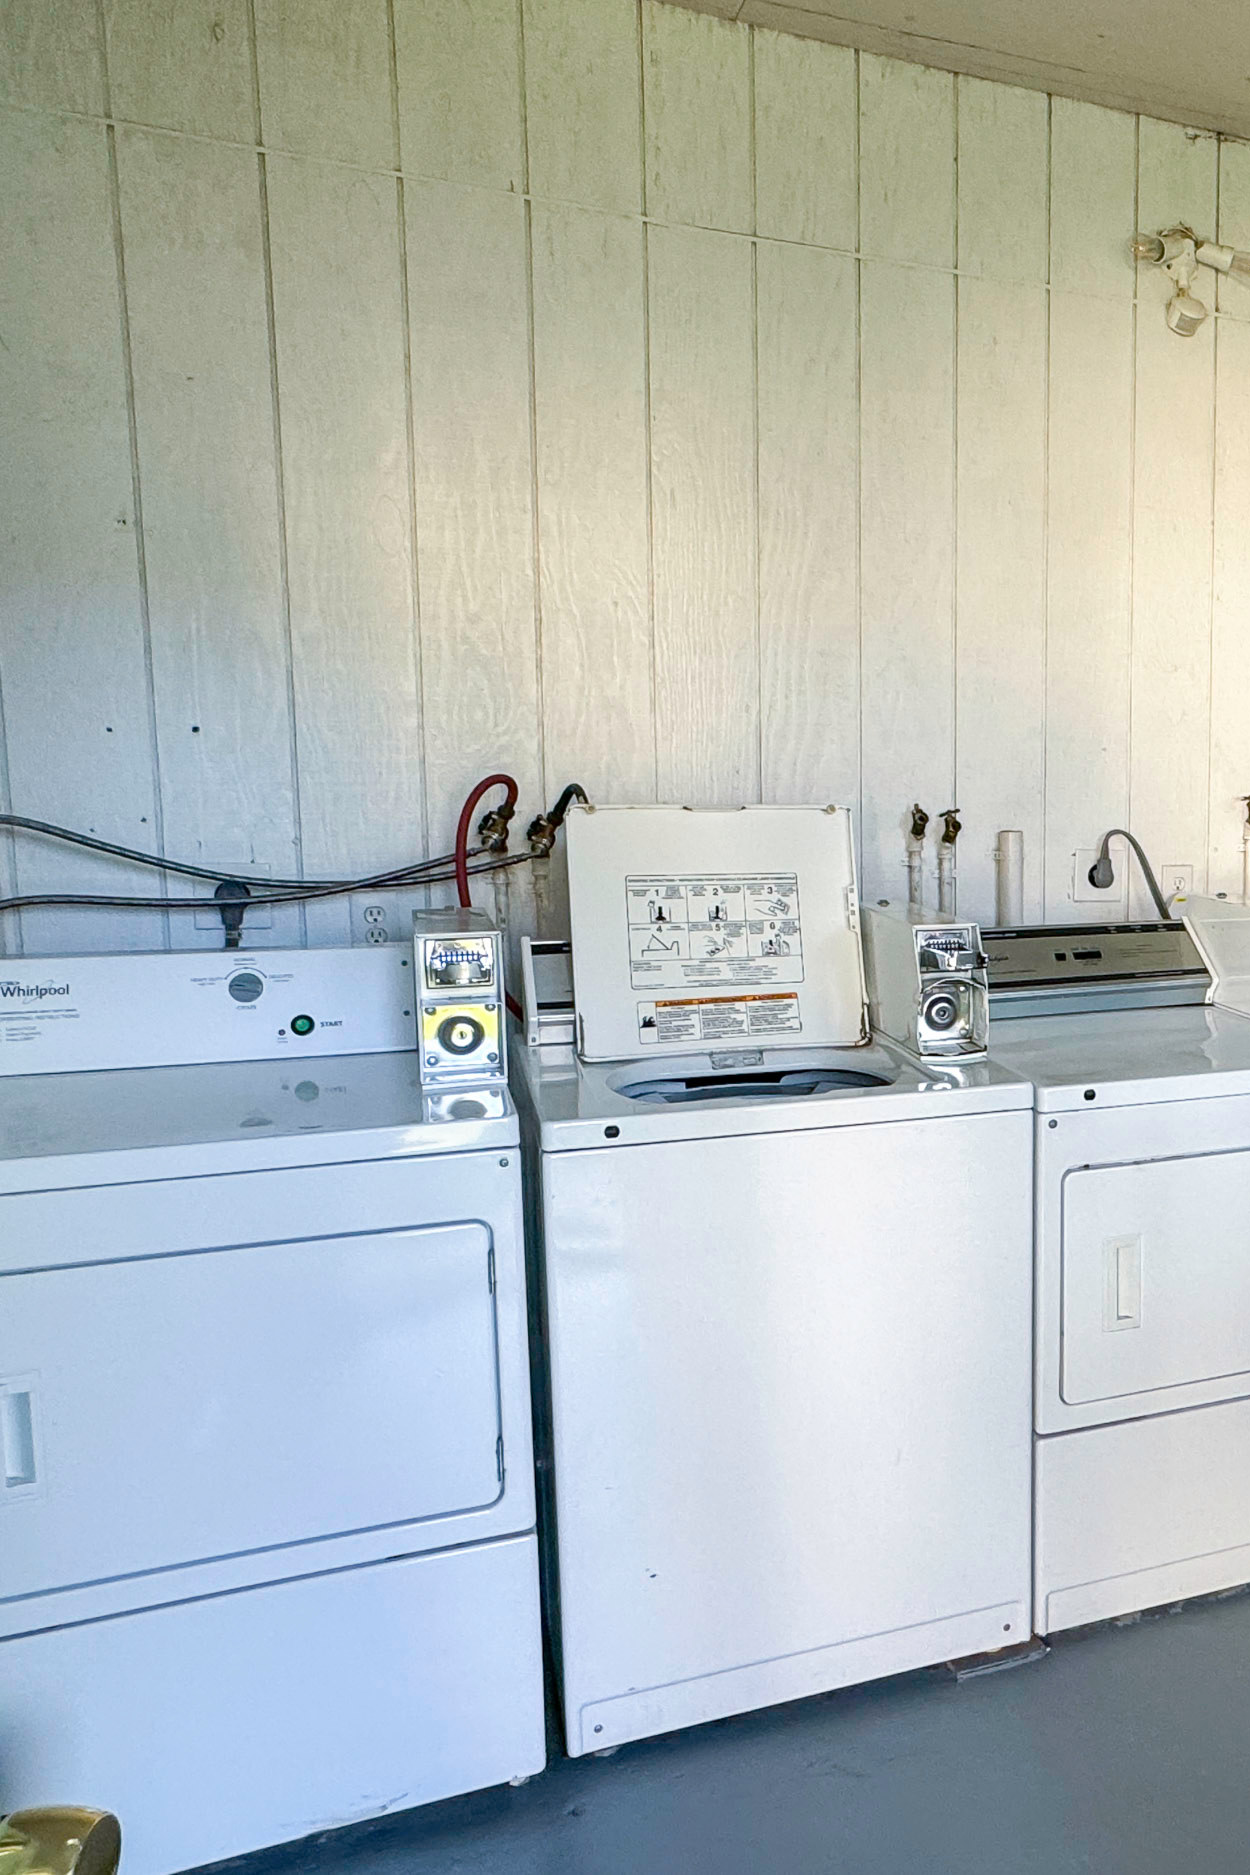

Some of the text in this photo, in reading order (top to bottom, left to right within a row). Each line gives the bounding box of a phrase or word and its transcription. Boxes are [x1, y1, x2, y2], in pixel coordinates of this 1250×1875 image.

[712, 888, 719, 896] 2
[767, 886, 773, 894] 3
[656, 925, 662, 933] 4
[0, 983, 70, 1000] Whirlpool
[320, 1020, 343, 1028] START
